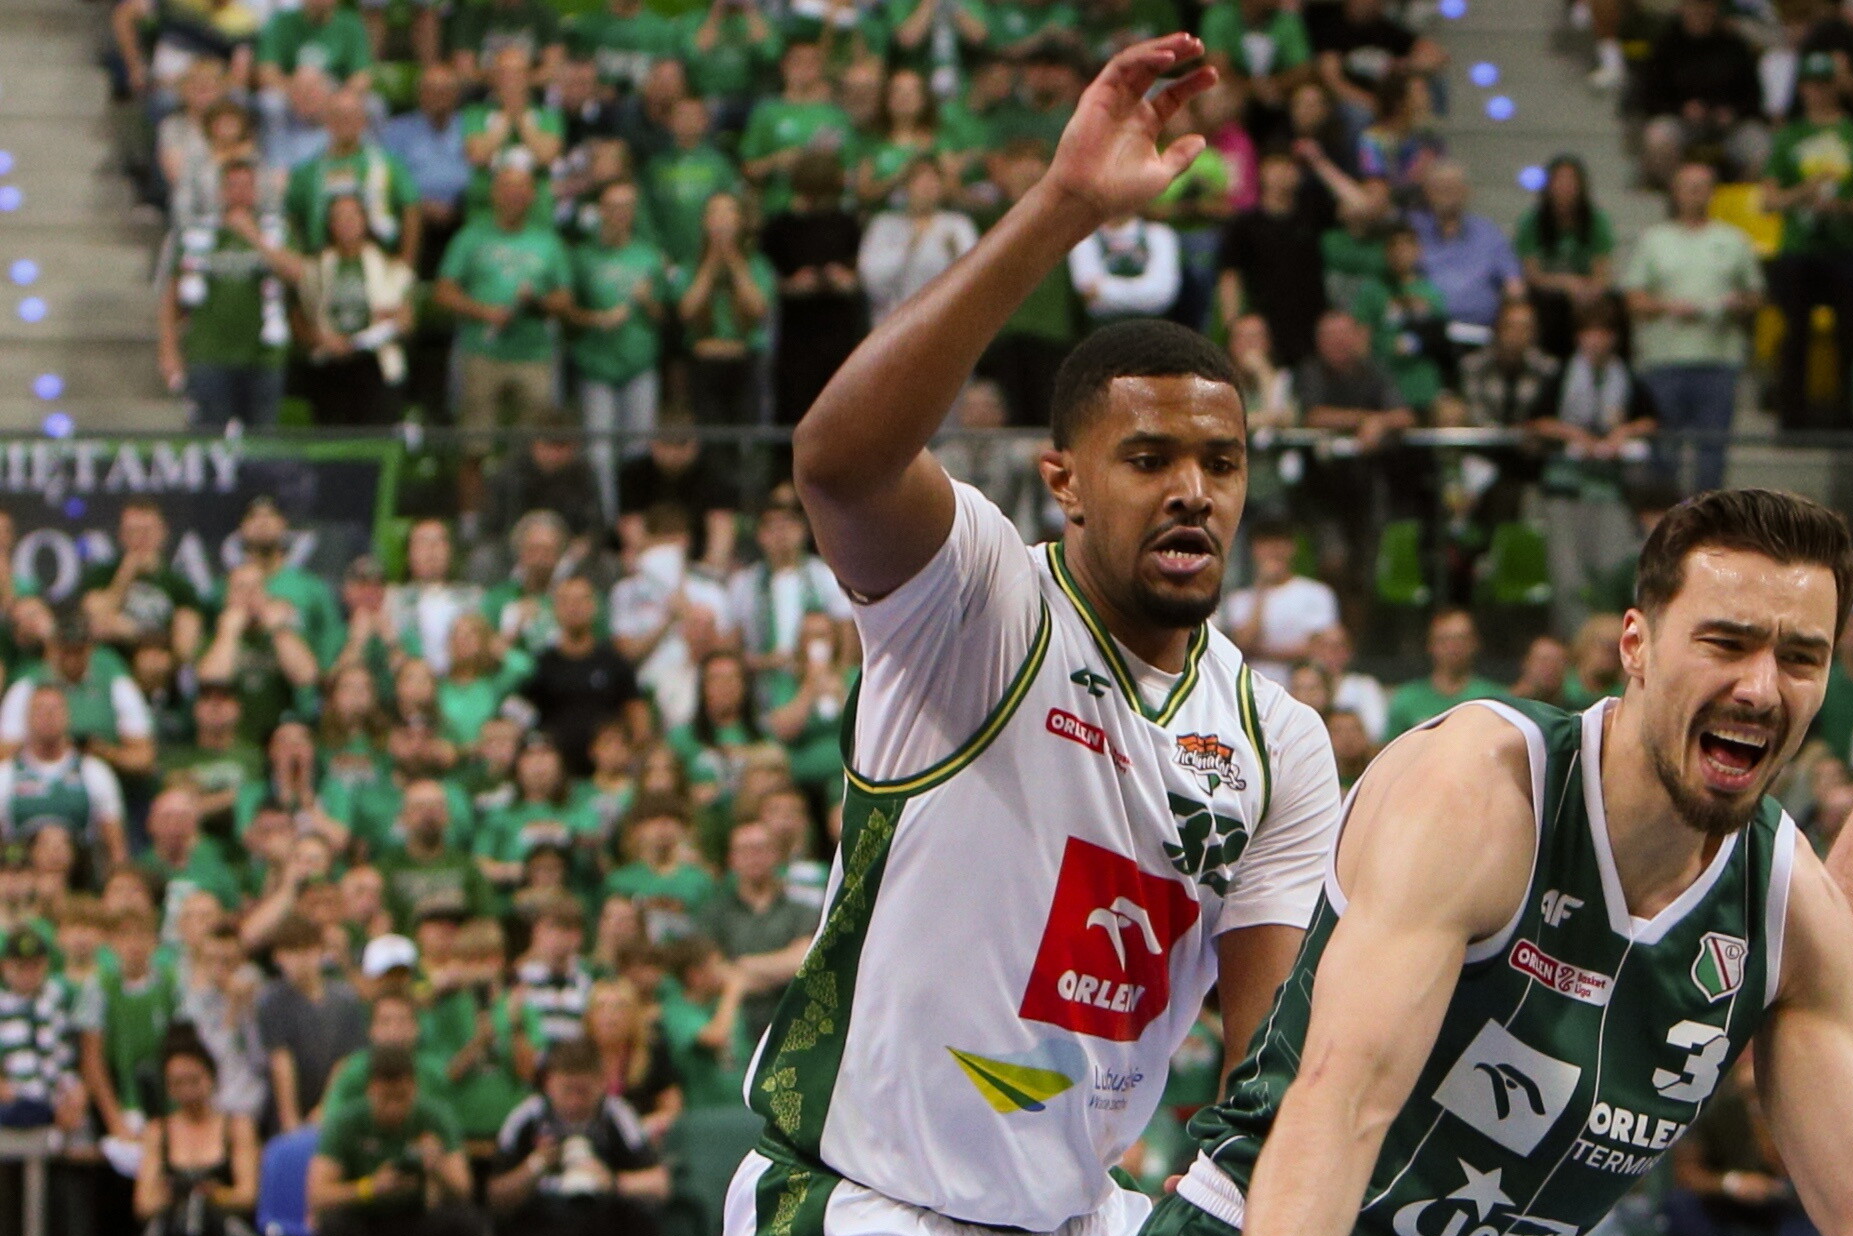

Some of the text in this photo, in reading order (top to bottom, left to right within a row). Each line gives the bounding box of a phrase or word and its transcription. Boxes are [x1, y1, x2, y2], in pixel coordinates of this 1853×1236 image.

[1051, 713, 1101, 747] ORLEN
[1518, 948, 1553, 981] ORLEN
[1057, 969, 1147, 1013] ORLEN
[1574, 983, 1592, 998] Liga
[1652, 1019, 1730, 1102] 3
